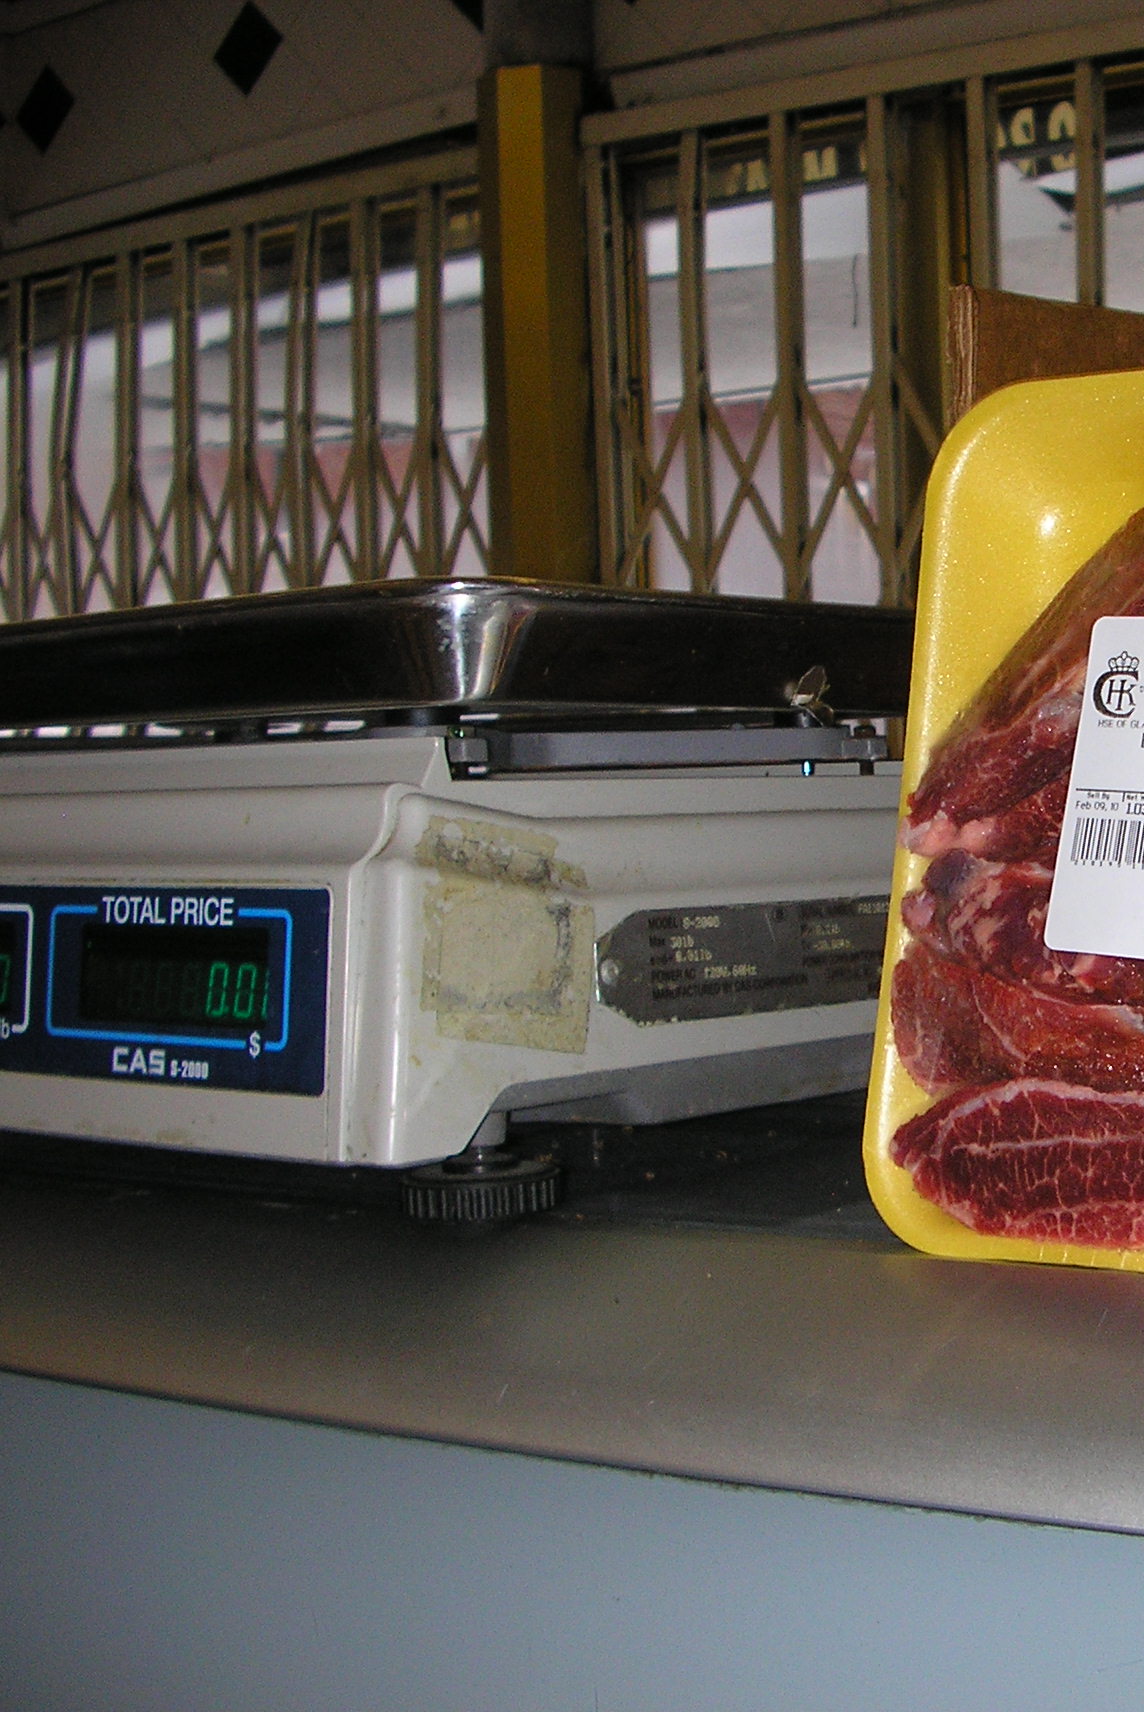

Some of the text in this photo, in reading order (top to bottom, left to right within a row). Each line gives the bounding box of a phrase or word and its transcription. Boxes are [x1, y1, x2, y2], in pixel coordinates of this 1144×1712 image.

[1116, 719, 1126, 728] OF
[1075, 800, 1091, 811] Feb
[1110, 802, 1119, 812] 10
[102, 896, 234, 926] TOTAL PRICE
[249, 1031, 261, 1059] $
[112, 1046, 166, 1076] CAS
